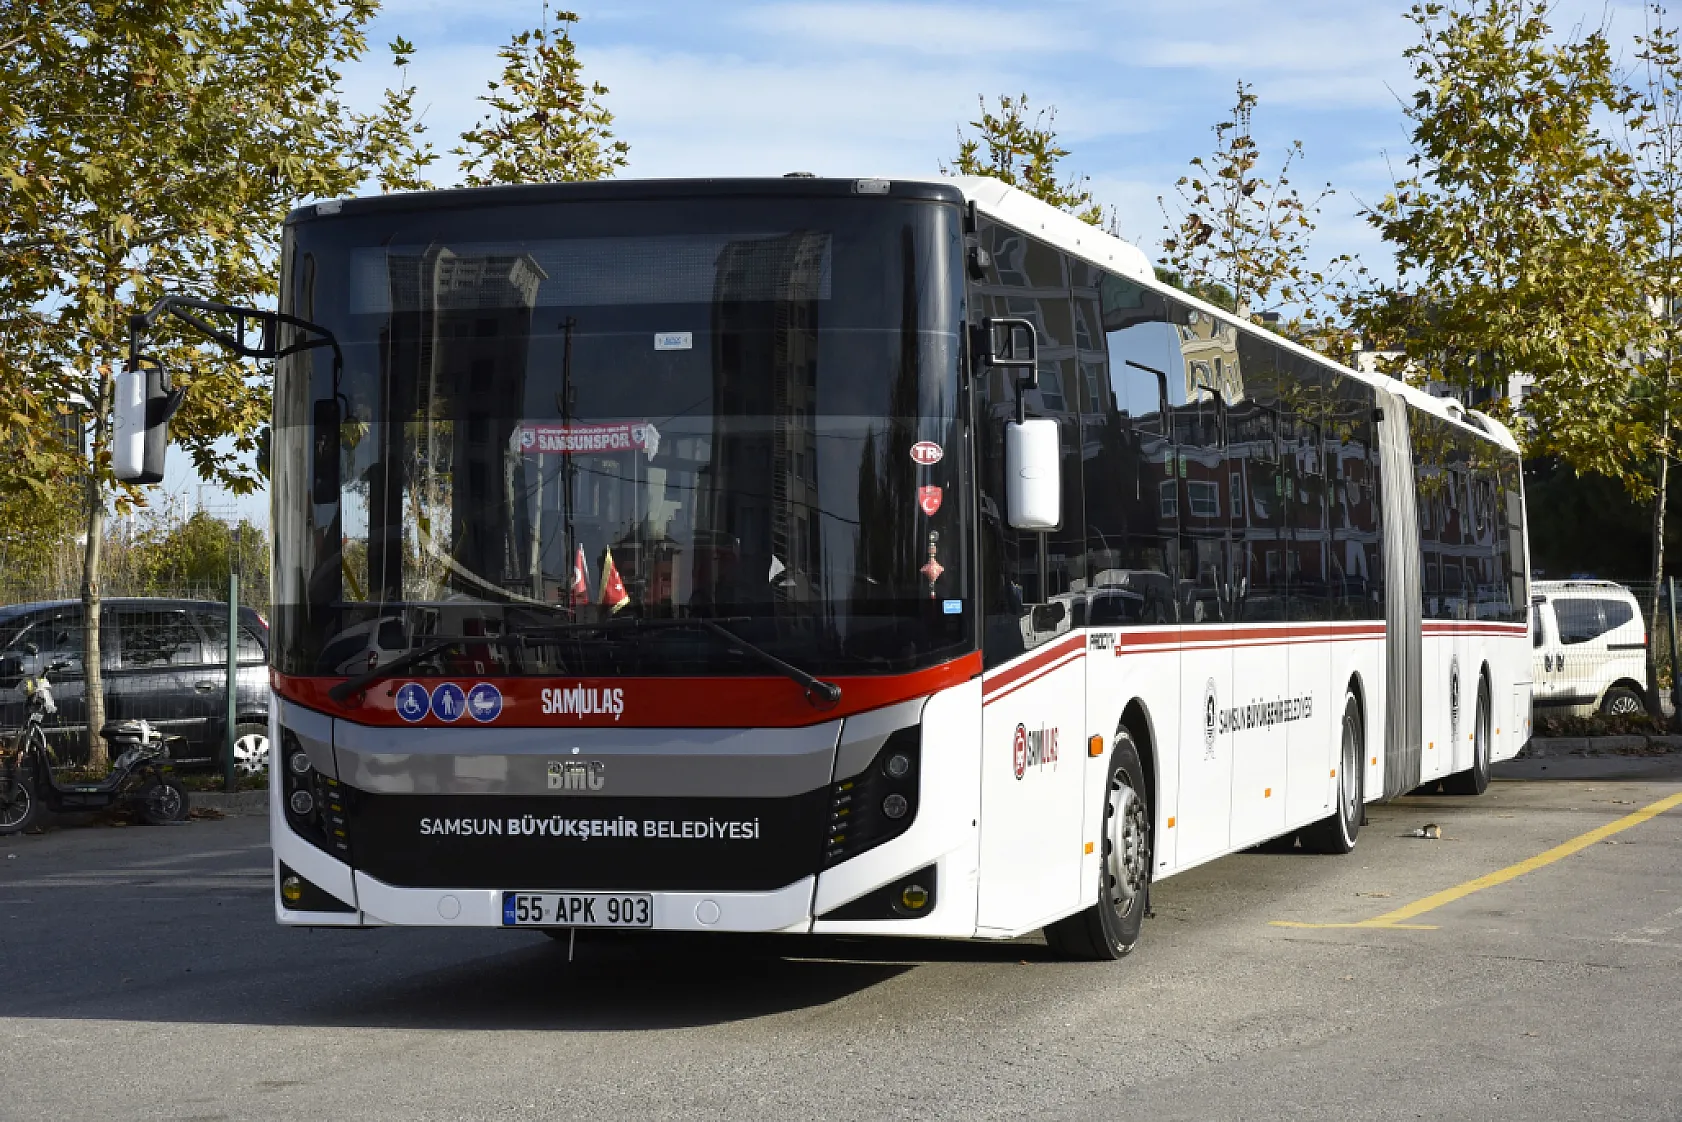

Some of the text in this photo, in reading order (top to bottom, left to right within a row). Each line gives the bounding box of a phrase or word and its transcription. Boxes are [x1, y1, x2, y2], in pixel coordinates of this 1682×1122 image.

[539, 433, 630, 450] SAMSUNSPOR
[915, 446, 938, 459] TR
[547, 760, 605, 790] BMC
[420, 814, 760, 842] SAMSUN BÜYÜKŞEHİR BELEDİYESİ
[516, 896, 650, 924] 55 APK 903
